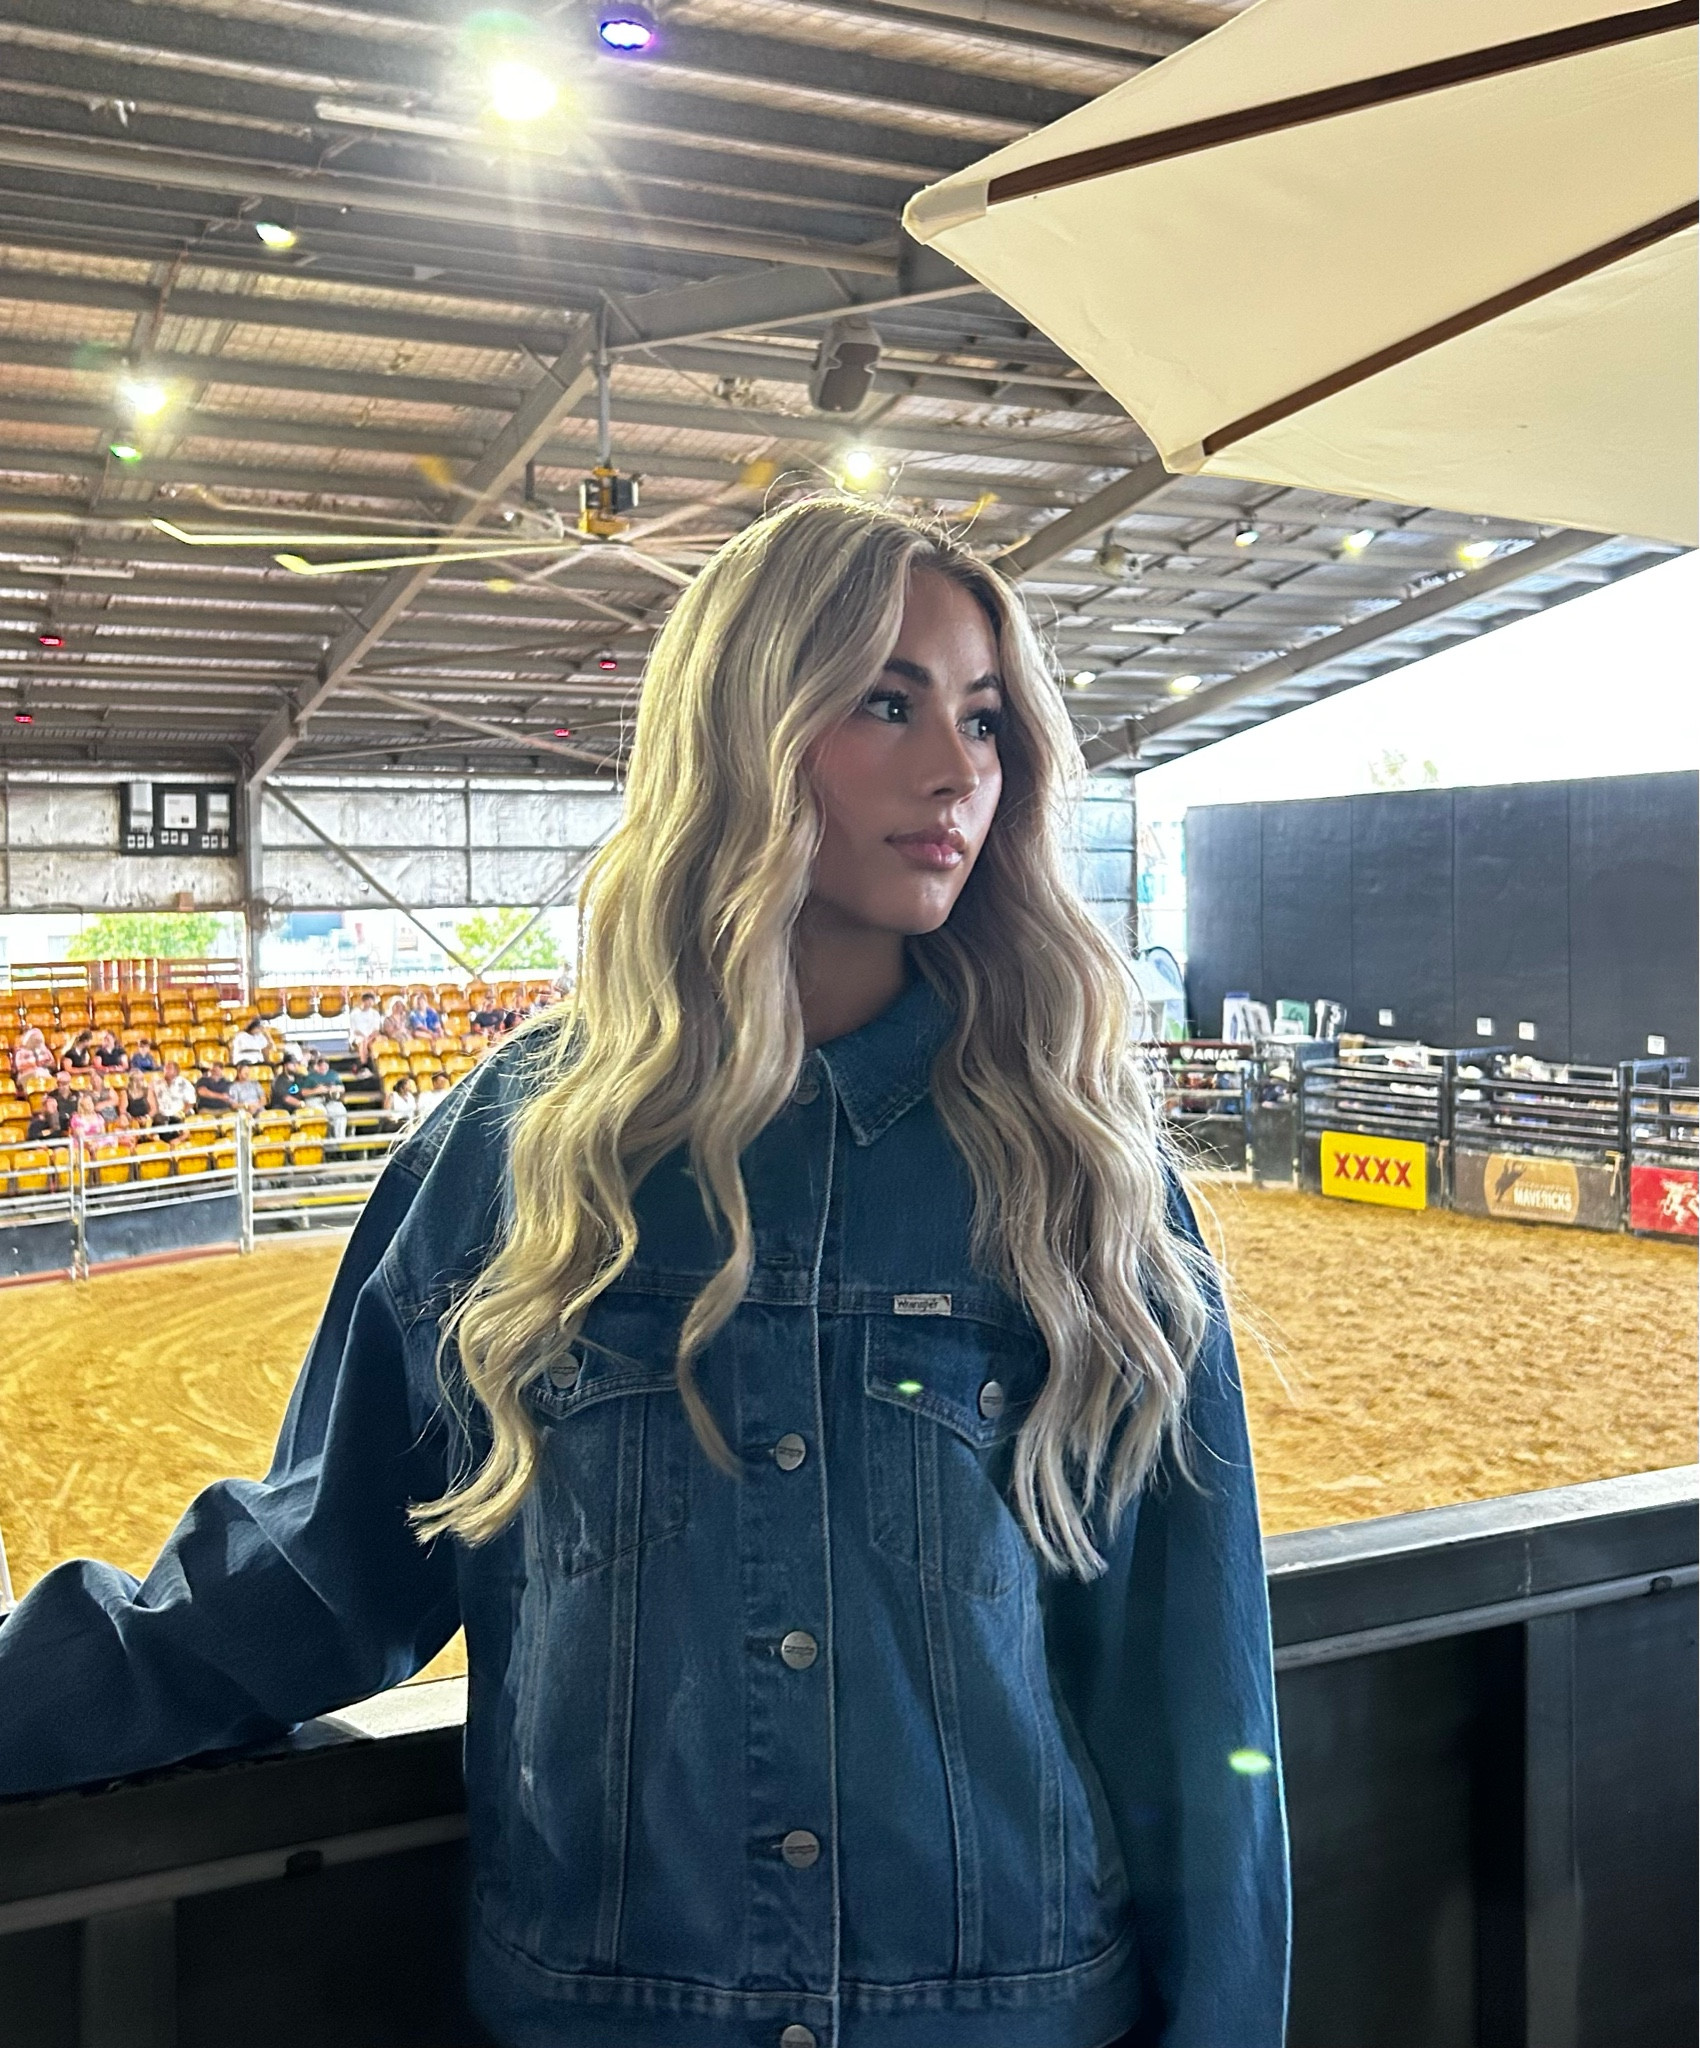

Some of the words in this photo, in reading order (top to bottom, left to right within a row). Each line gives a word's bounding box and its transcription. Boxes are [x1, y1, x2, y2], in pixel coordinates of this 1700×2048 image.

[1193, 1048, 1240, 1060] ARIAT
[1333, 1152, 1412, 1189] XXXX
[1513, 1187, 1572, 1212] MAVERICKS
[895, 1298, 938, 1311] Wrangler
